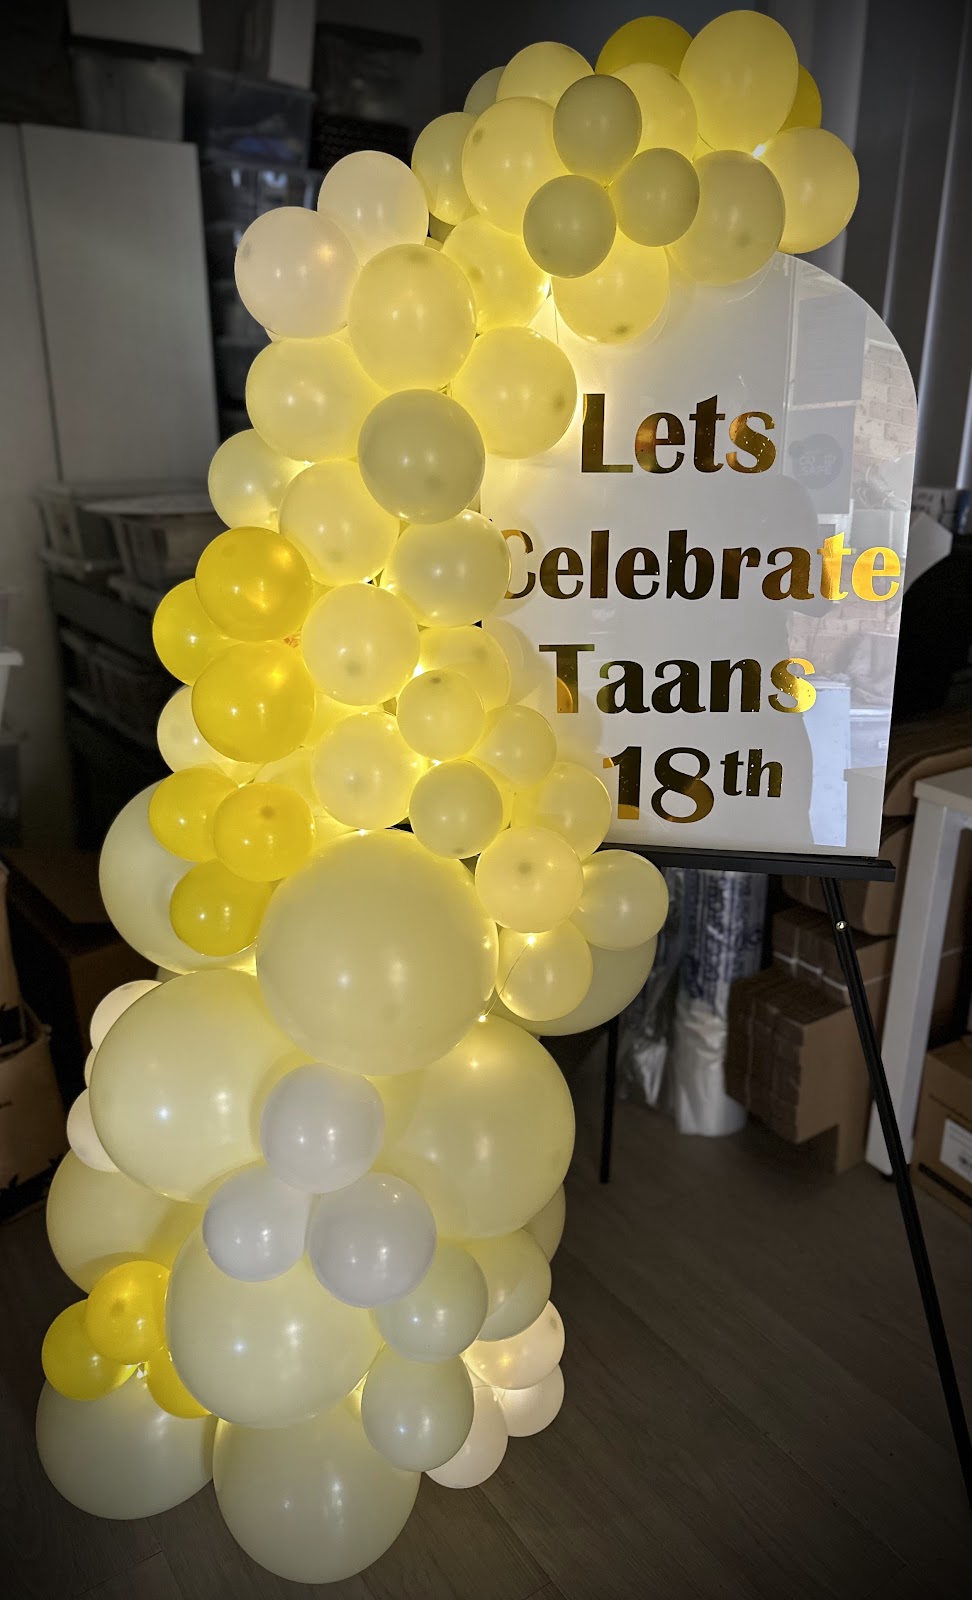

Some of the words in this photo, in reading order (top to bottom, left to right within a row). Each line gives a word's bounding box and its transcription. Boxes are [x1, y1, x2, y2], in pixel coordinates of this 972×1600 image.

[580, 393, 777, 474] Lets
[500, 529, 901, 602] Celebrate
[538, 643, 817, 714] Taans
[602, 745, 784, 824] 18th
